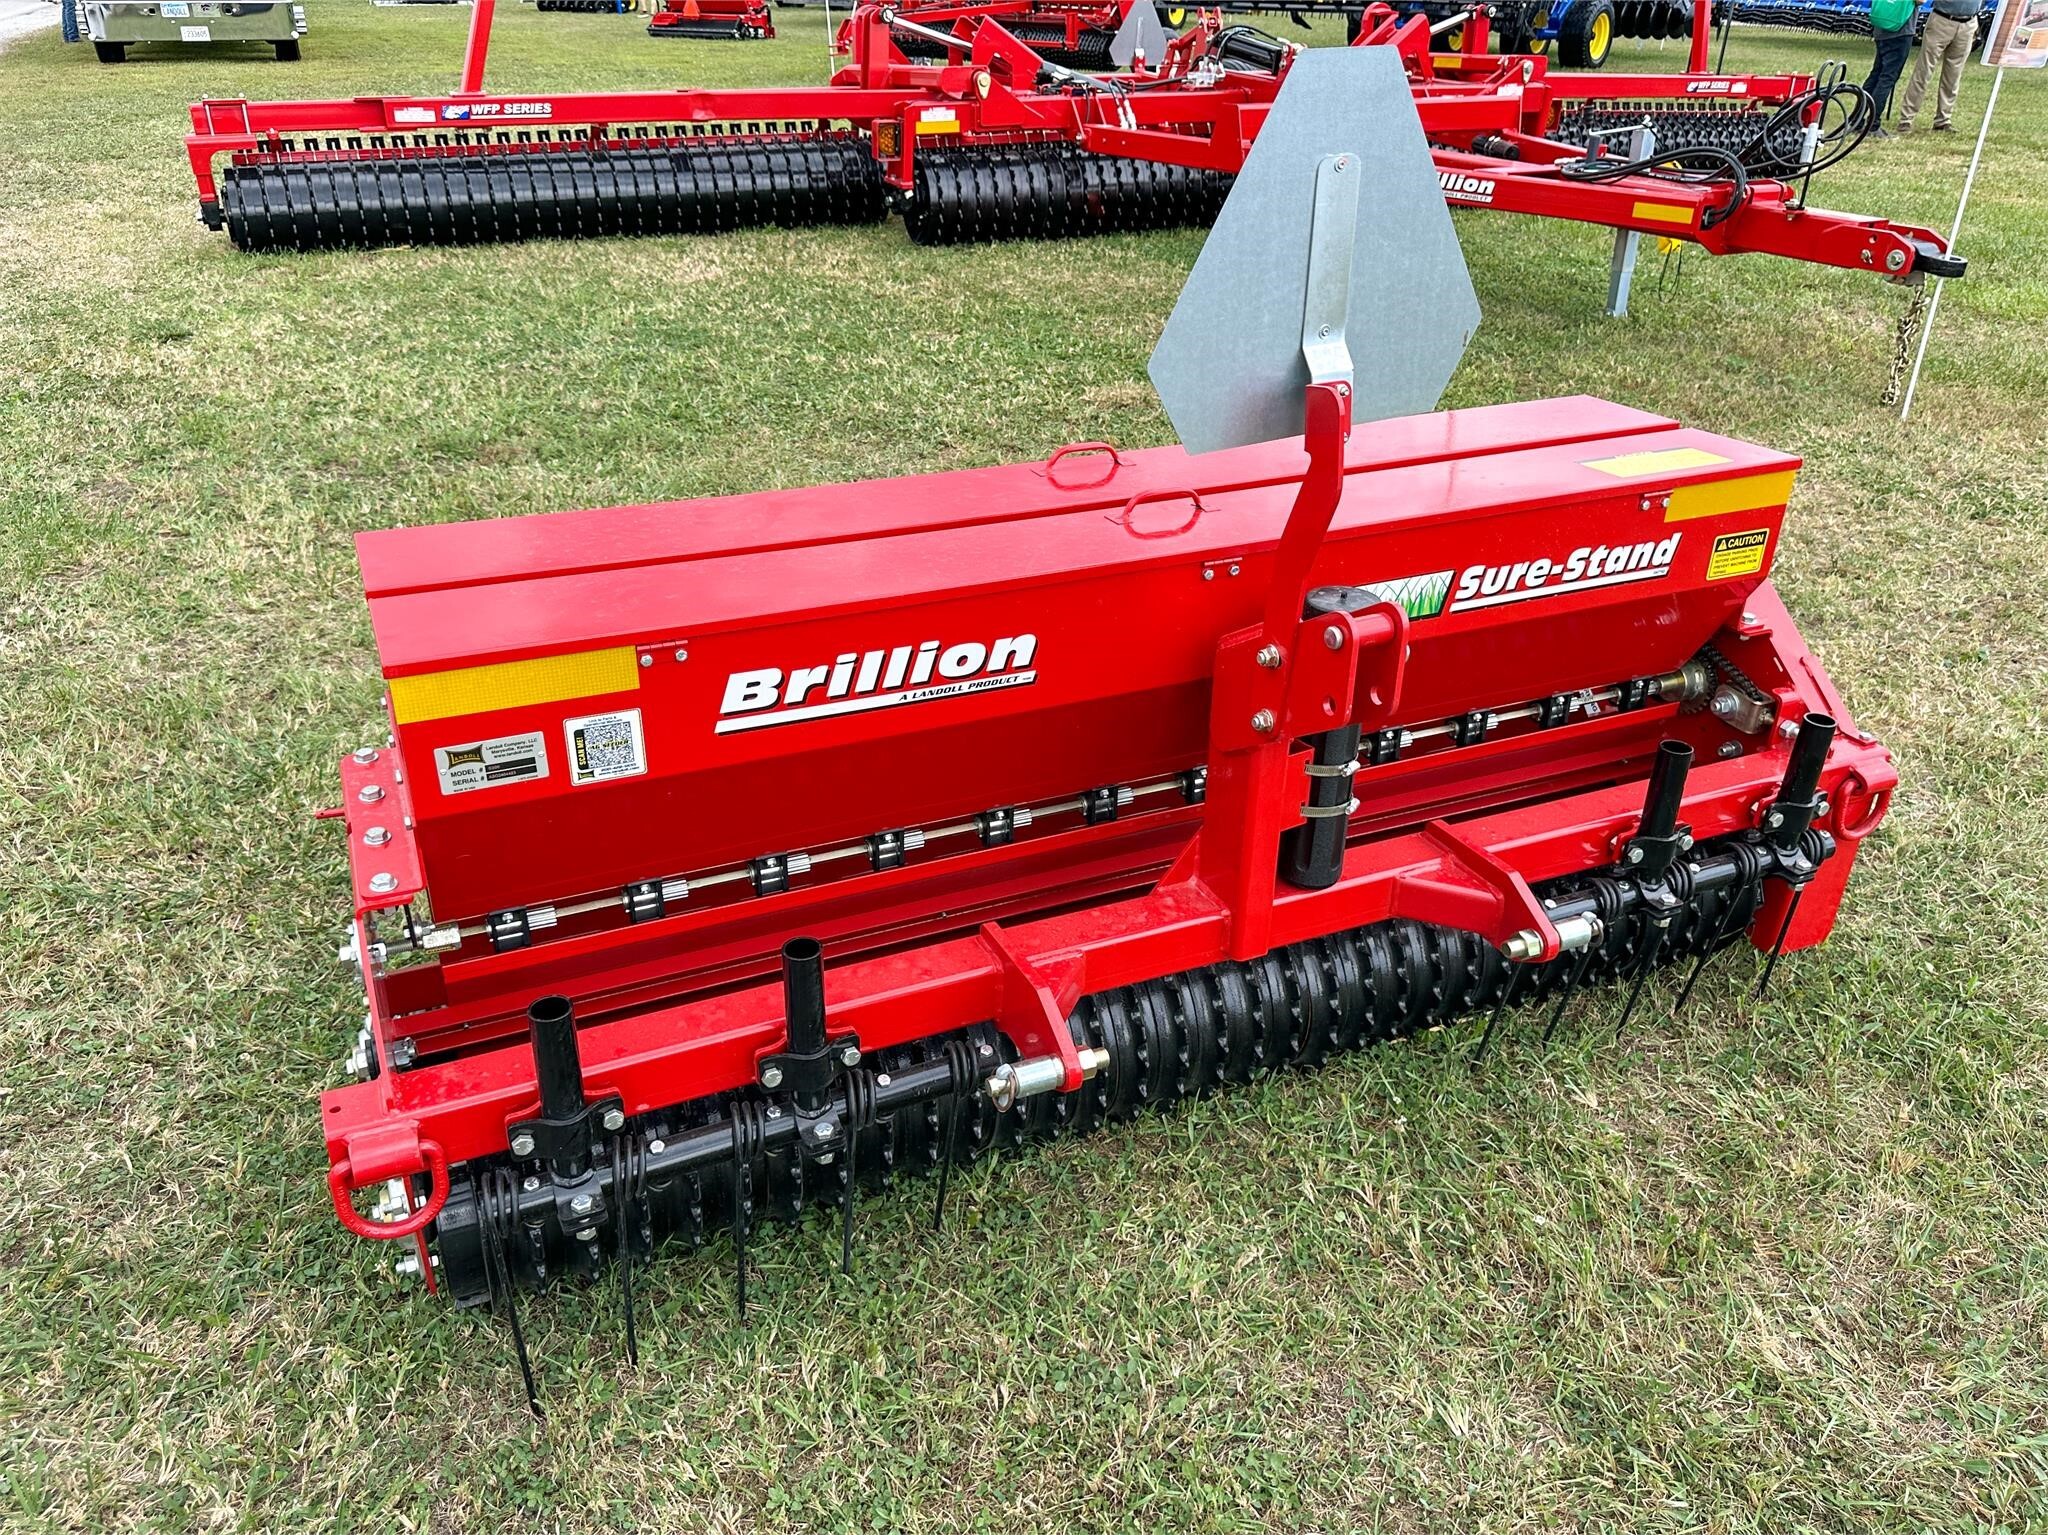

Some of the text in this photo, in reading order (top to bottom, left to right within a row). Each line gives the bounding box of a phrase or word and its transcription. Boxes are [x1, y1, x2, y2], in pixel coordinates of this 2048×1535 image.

[470, 104, 500, 115] WFP
[503, 103, 552, 115] SERIES
[1437, 172, 1496, 196] llion
[1728, 534, 1765, 548] CAUTION
[1454, 532, 1683, 601] Sure-Stand
[719, 633, 1039, 716] Brillion
[912, 684, 964, 700] LANDOLL
[967, 675, 1019, 690] PRODUCT
[450, 753, 480, 765] LANDOLL
[578, 750, 586, 766] SCAN
[450, 768, 477, 778] MODEL
[452, 776, 479, 786] SERIAL
